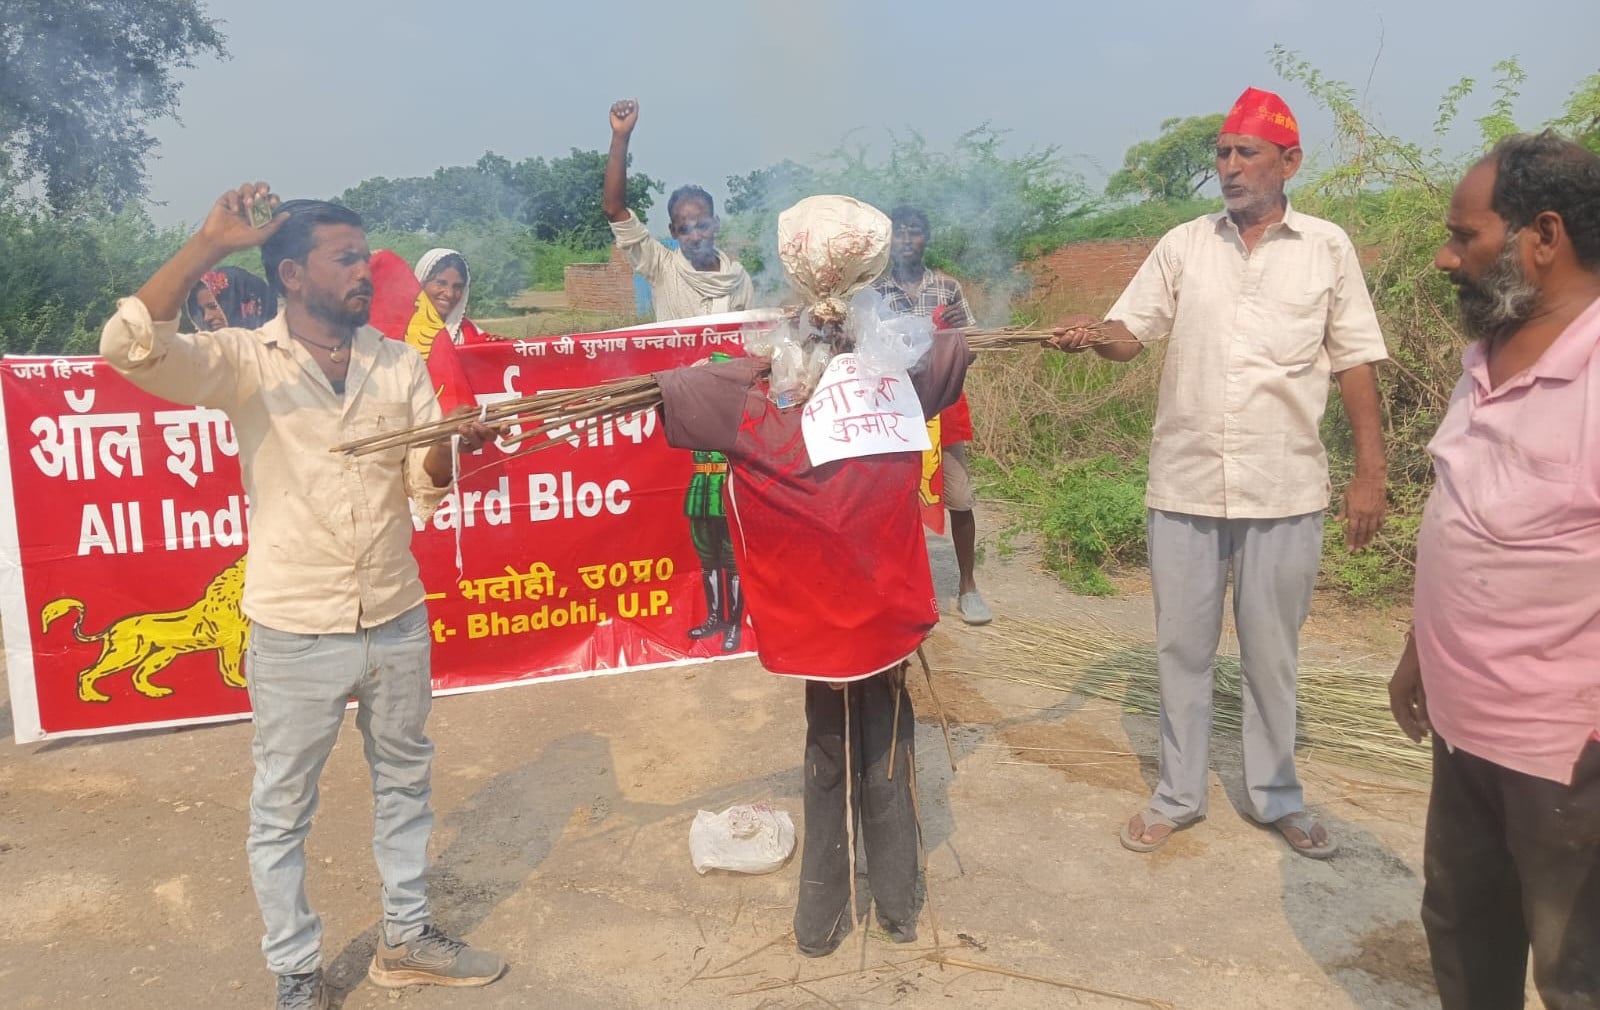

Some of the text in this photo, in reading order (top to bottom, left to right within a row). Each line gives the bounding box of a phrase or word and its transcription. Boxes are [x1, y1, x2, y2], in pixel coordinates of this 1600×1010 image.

[514, 339, 546, 356] नेता
[554, 335, 574, 355] जी
[581, 337, 626, 358] सुभाष
[633, 329, 695, 351] चन्द्रबोस
[11, 359, 95, 379] जय हिन्द
[30, 389, 143, 481] ऑल
[829, 411, 910, 443] कुमार
[77, 501, 143, 556] All
[161, 495, 250, 551] Ind
[529, 471, 631, 522] Bloc
[459, 561, 569, 604] भदोही,
[468, 597, 607, 640] Bhadohi,
[617, 590, 673, 618] U.P.
